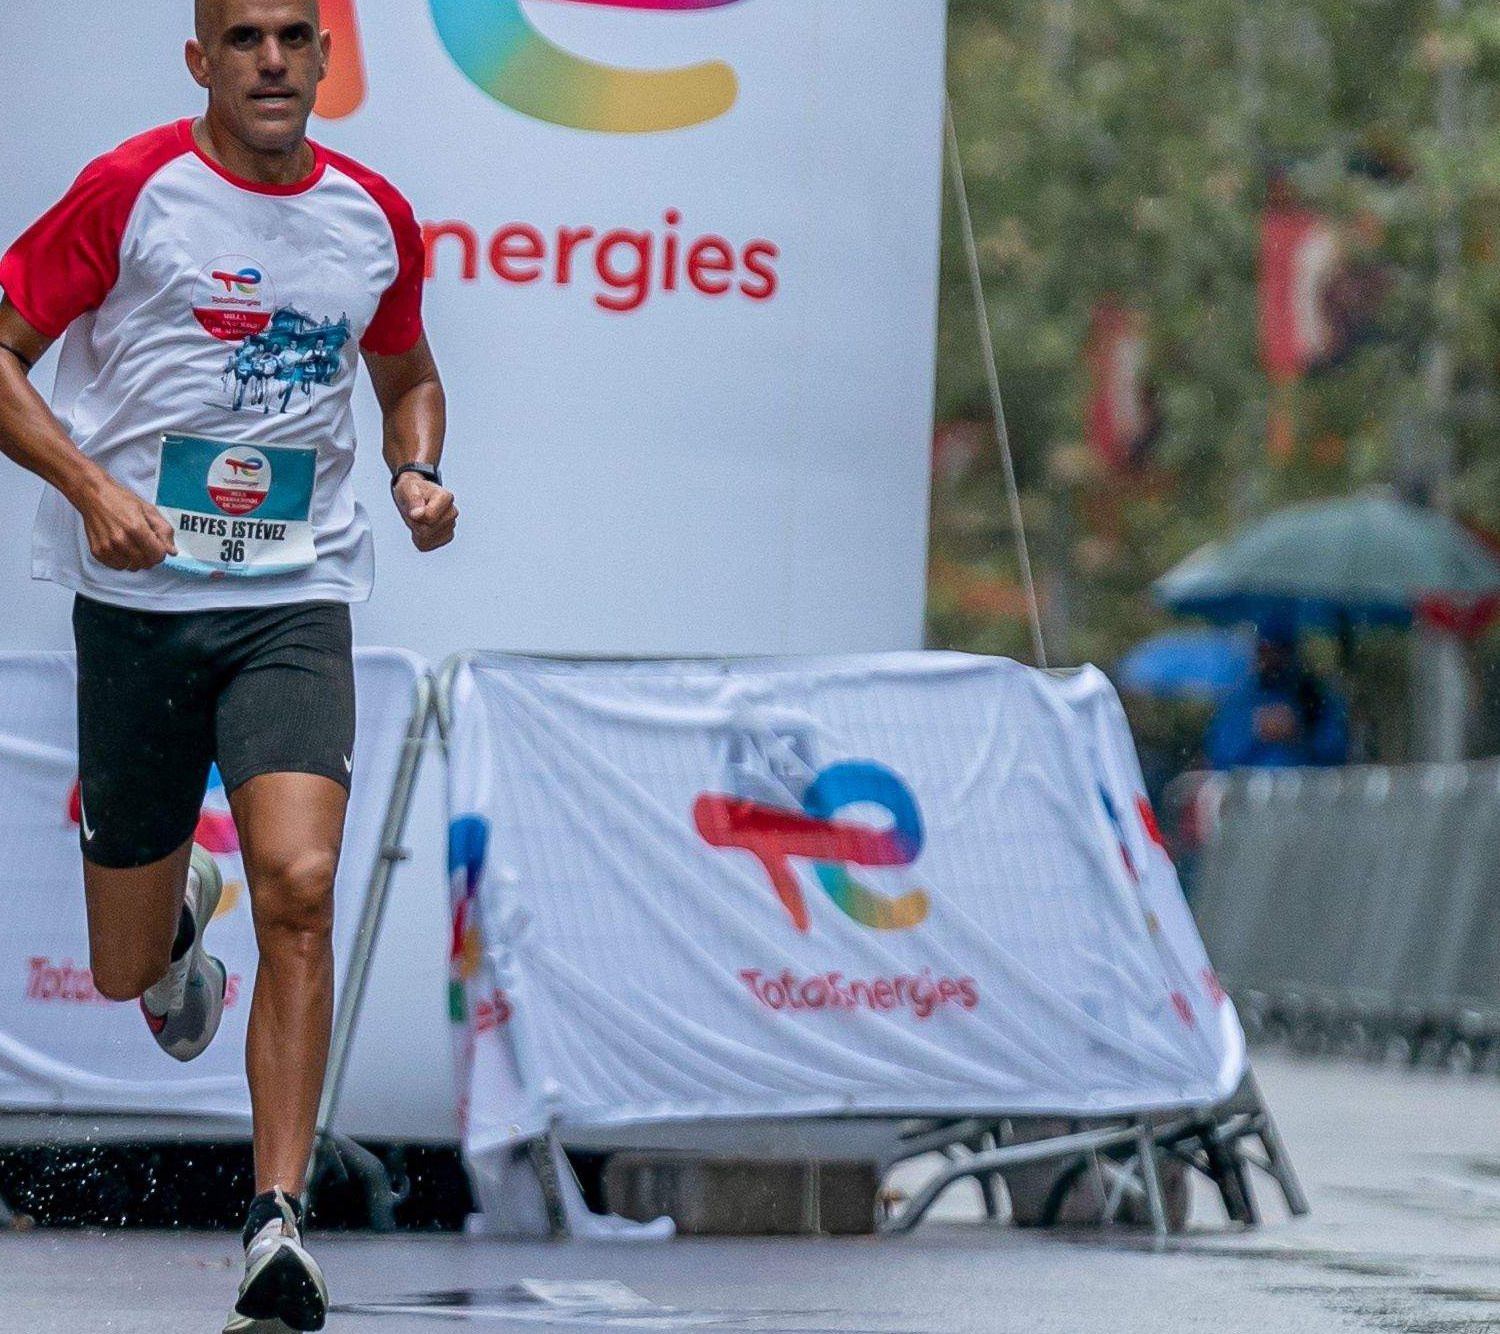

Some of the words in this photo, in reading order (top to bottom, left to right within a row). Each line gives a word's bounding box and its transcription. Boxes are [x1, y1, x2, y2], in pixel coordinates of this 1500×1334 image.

[422, 205, 783, 313] nergies
[179, 513, 228, 537] REYES
[231, 519, 287, 541] ESTÉVEZ
[220, 539, 245, 563] 36
[736, 966, 980, 1021] Totanergies
